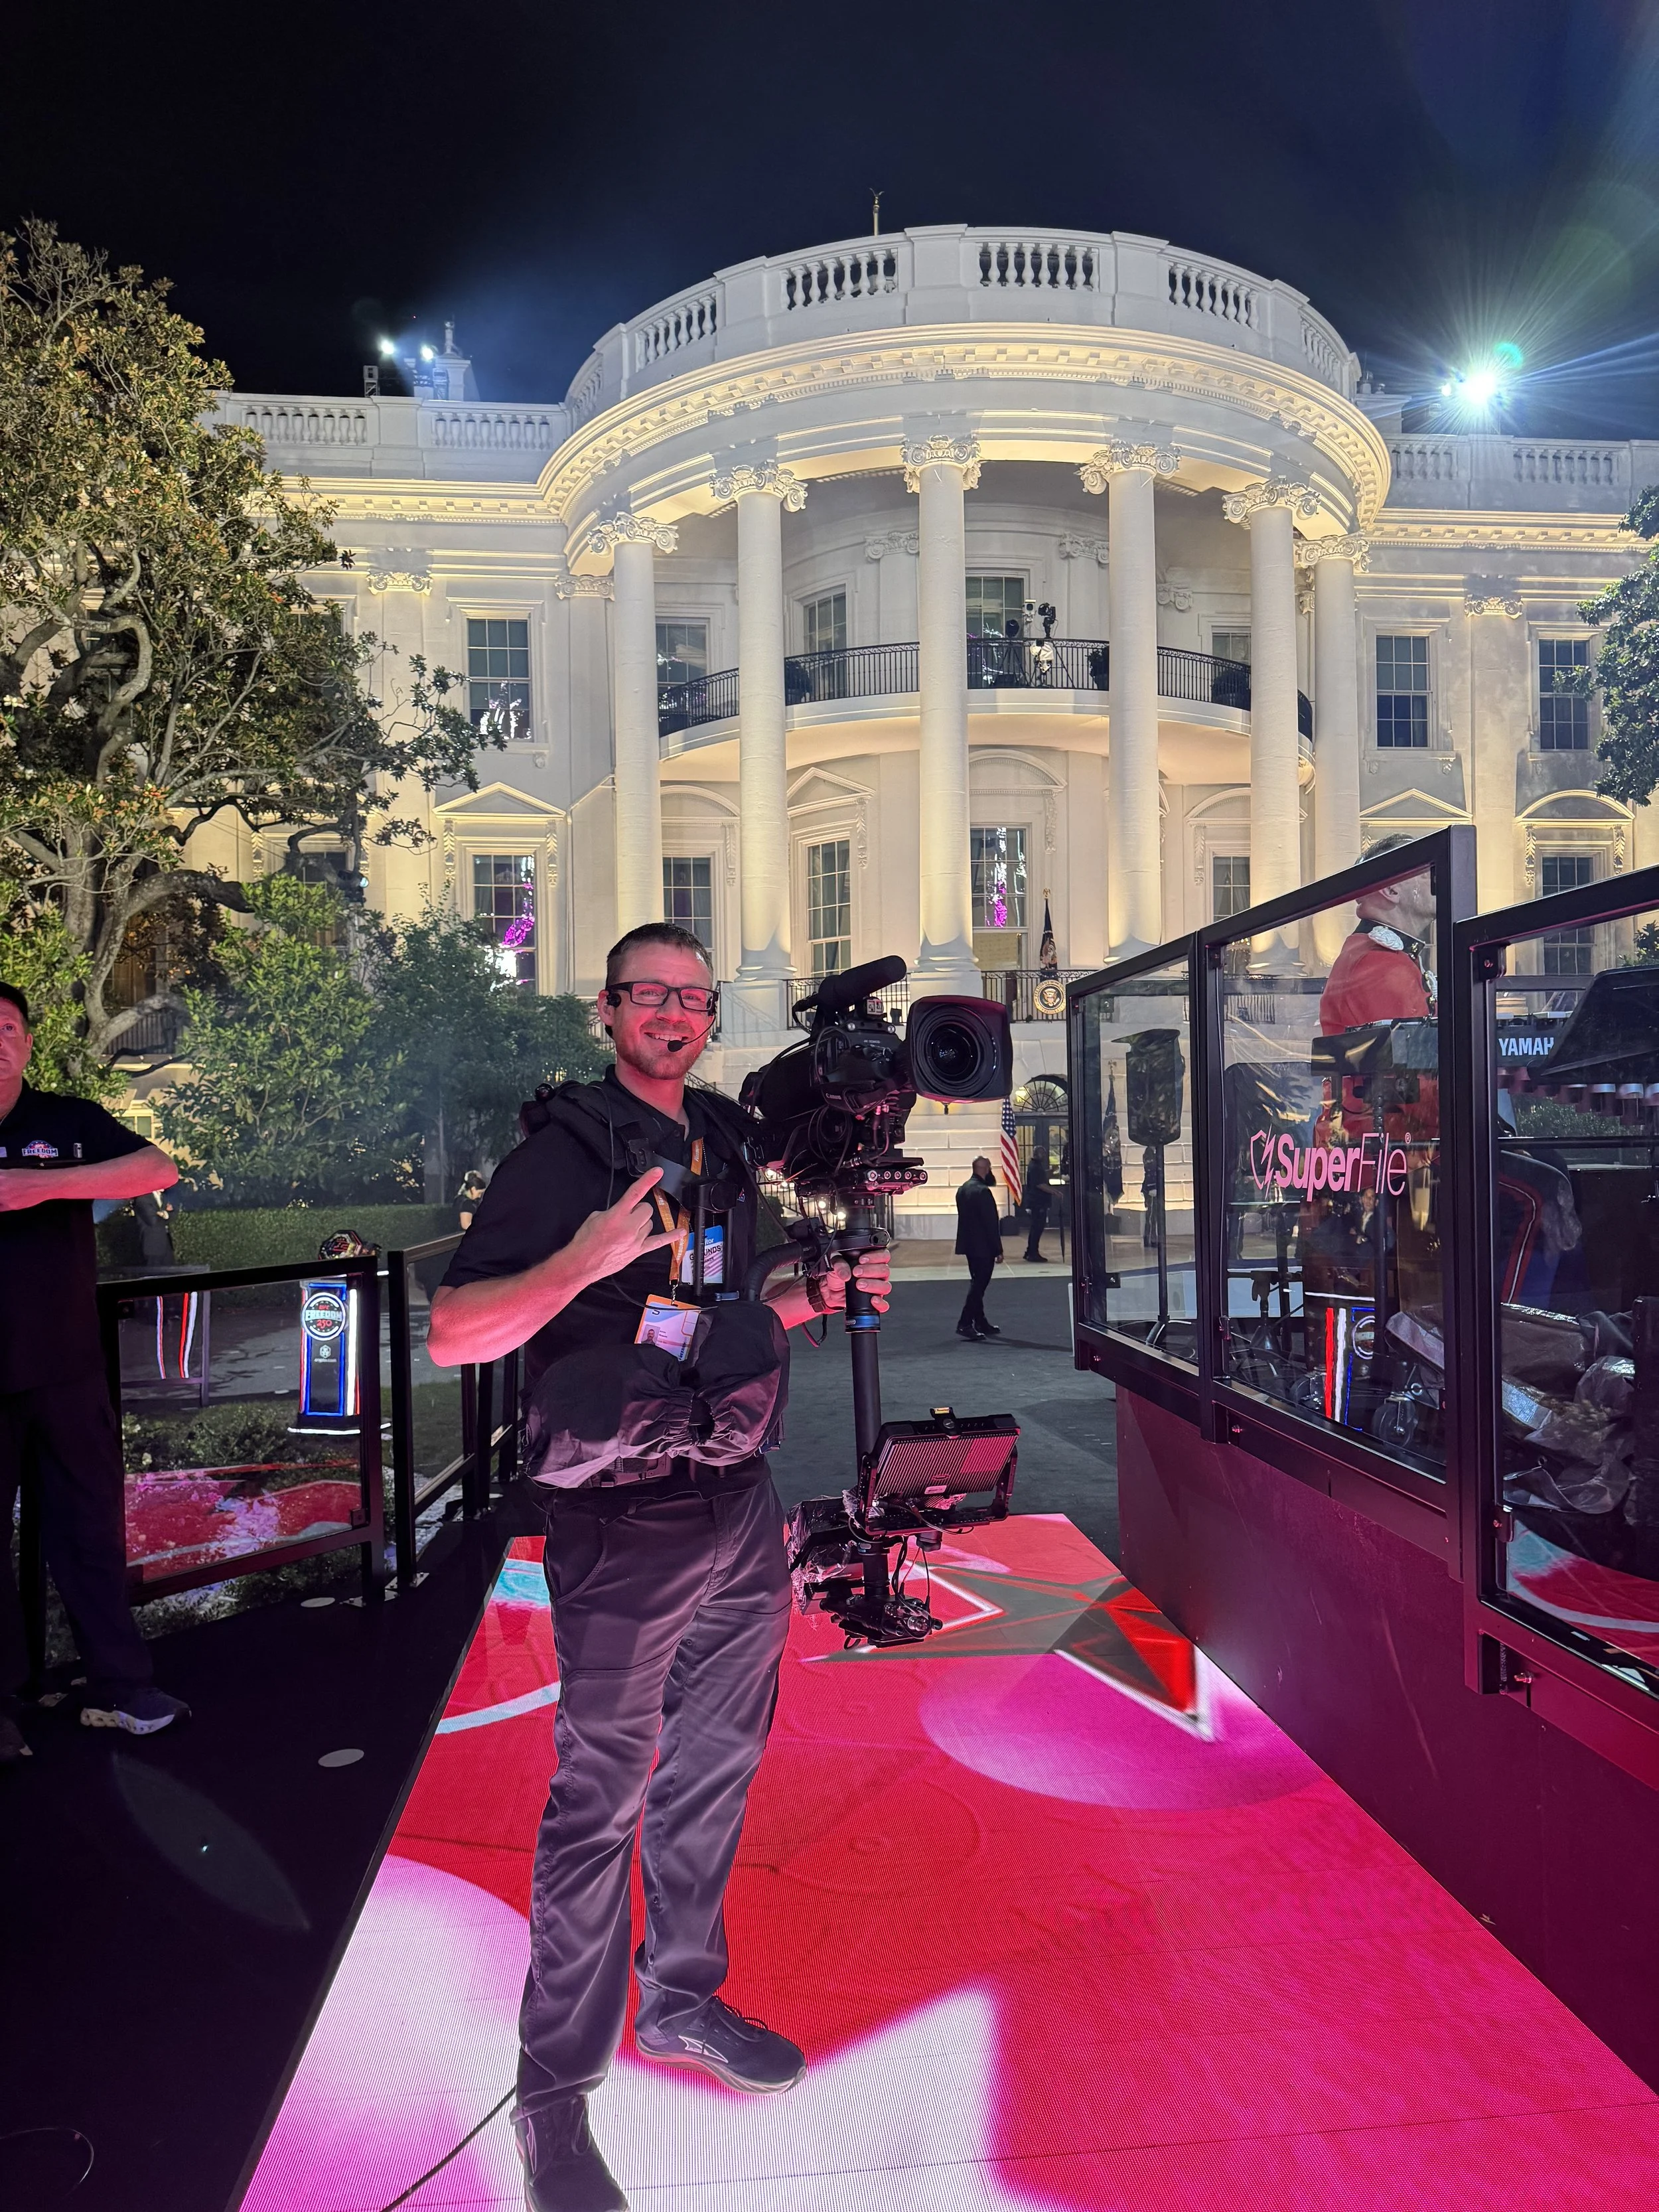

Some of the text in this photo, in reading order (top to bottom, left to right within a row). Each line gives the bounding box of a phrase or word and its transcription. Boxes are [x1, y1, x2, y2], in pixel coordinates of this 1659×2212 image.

[1498, 1037, 1554, 1056] YAMAH
[689, 1245, 721, 1260] GUNDS
[305, 1309, 342, 1321] FREEDOM
[316, 1319, 332, 1329] 250
